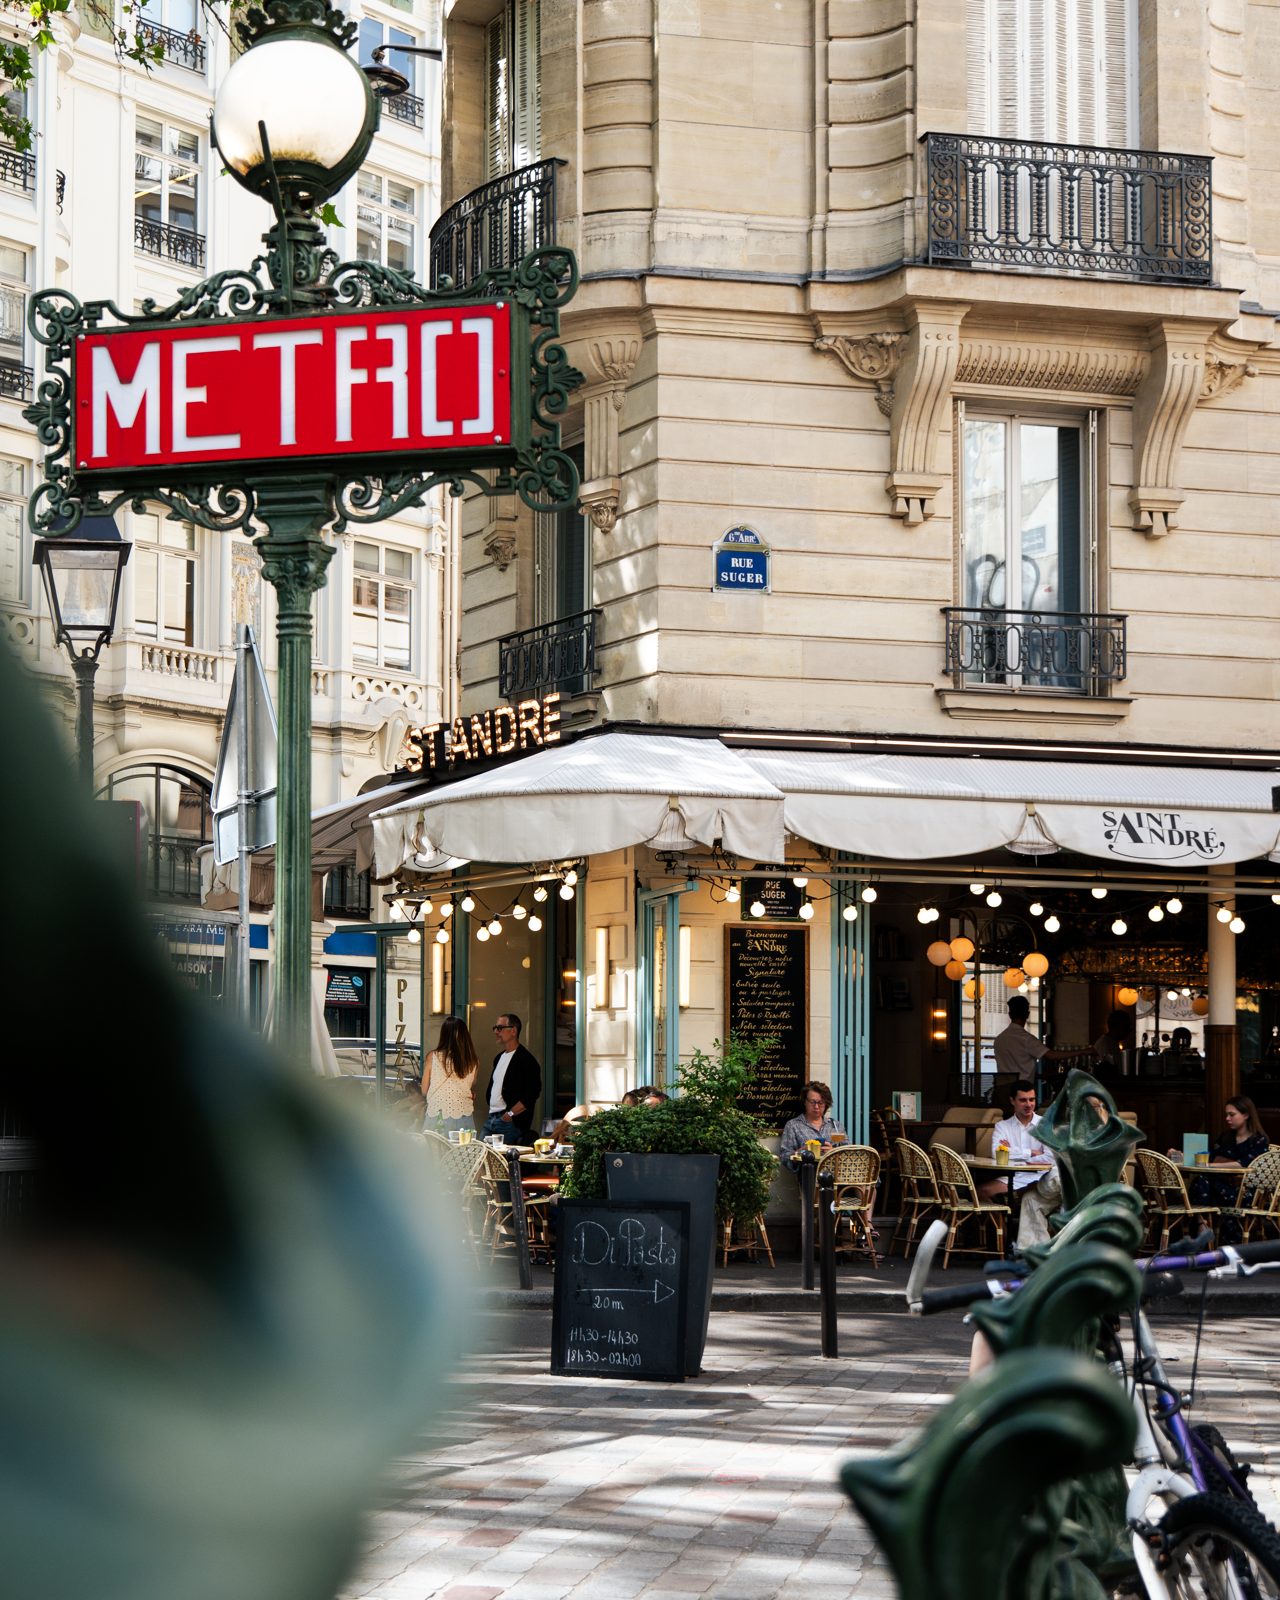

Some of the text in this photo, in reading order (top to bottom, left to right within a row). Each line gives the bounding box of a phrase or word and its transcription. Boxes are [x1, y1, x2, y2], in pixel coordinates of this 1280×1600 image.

[91, 316, 494, 458] METRO
[731, 557, 753, 568] RUE
[721, 572, 763, 583] SUGER
[406, 692, 561, 772] ST ANDRE
[1104, 817, 1220, 853] ANDRÉ
[761, 891, 786, 899] SUGER
[745, 929, 788, 939] Bienvenue
[745, 967, 785, 978] Signature
